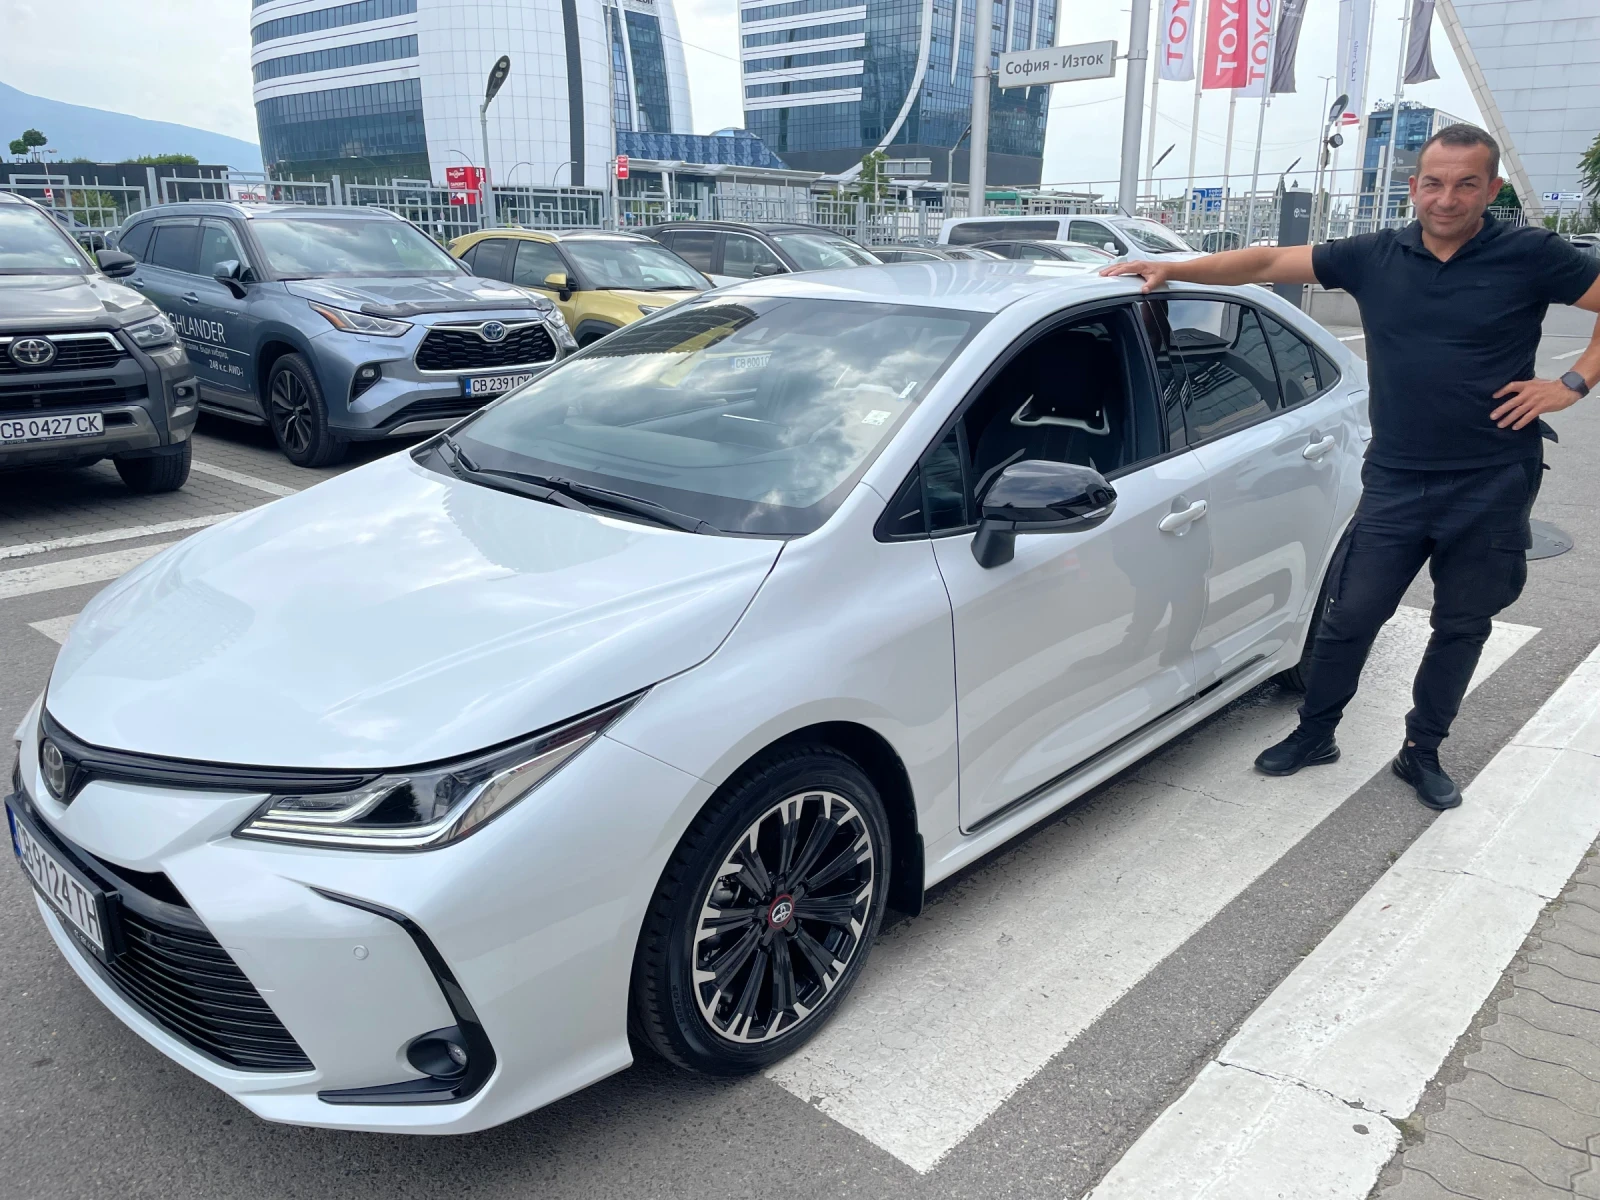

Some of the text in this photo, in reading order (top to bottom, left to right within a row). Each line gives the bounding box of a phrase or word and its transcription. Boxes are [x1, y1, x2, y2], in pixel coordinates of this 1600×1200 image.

[1005, 59, 1050, 76] София
[1062, 53, 1104, 69] Изток
[161, 310, 226, 344] GHLANDER
[472, 379, 488, 392] CB
[489, 376, 515, 392] 2391
[0, 415, 100, 439] CB 0427 CK
